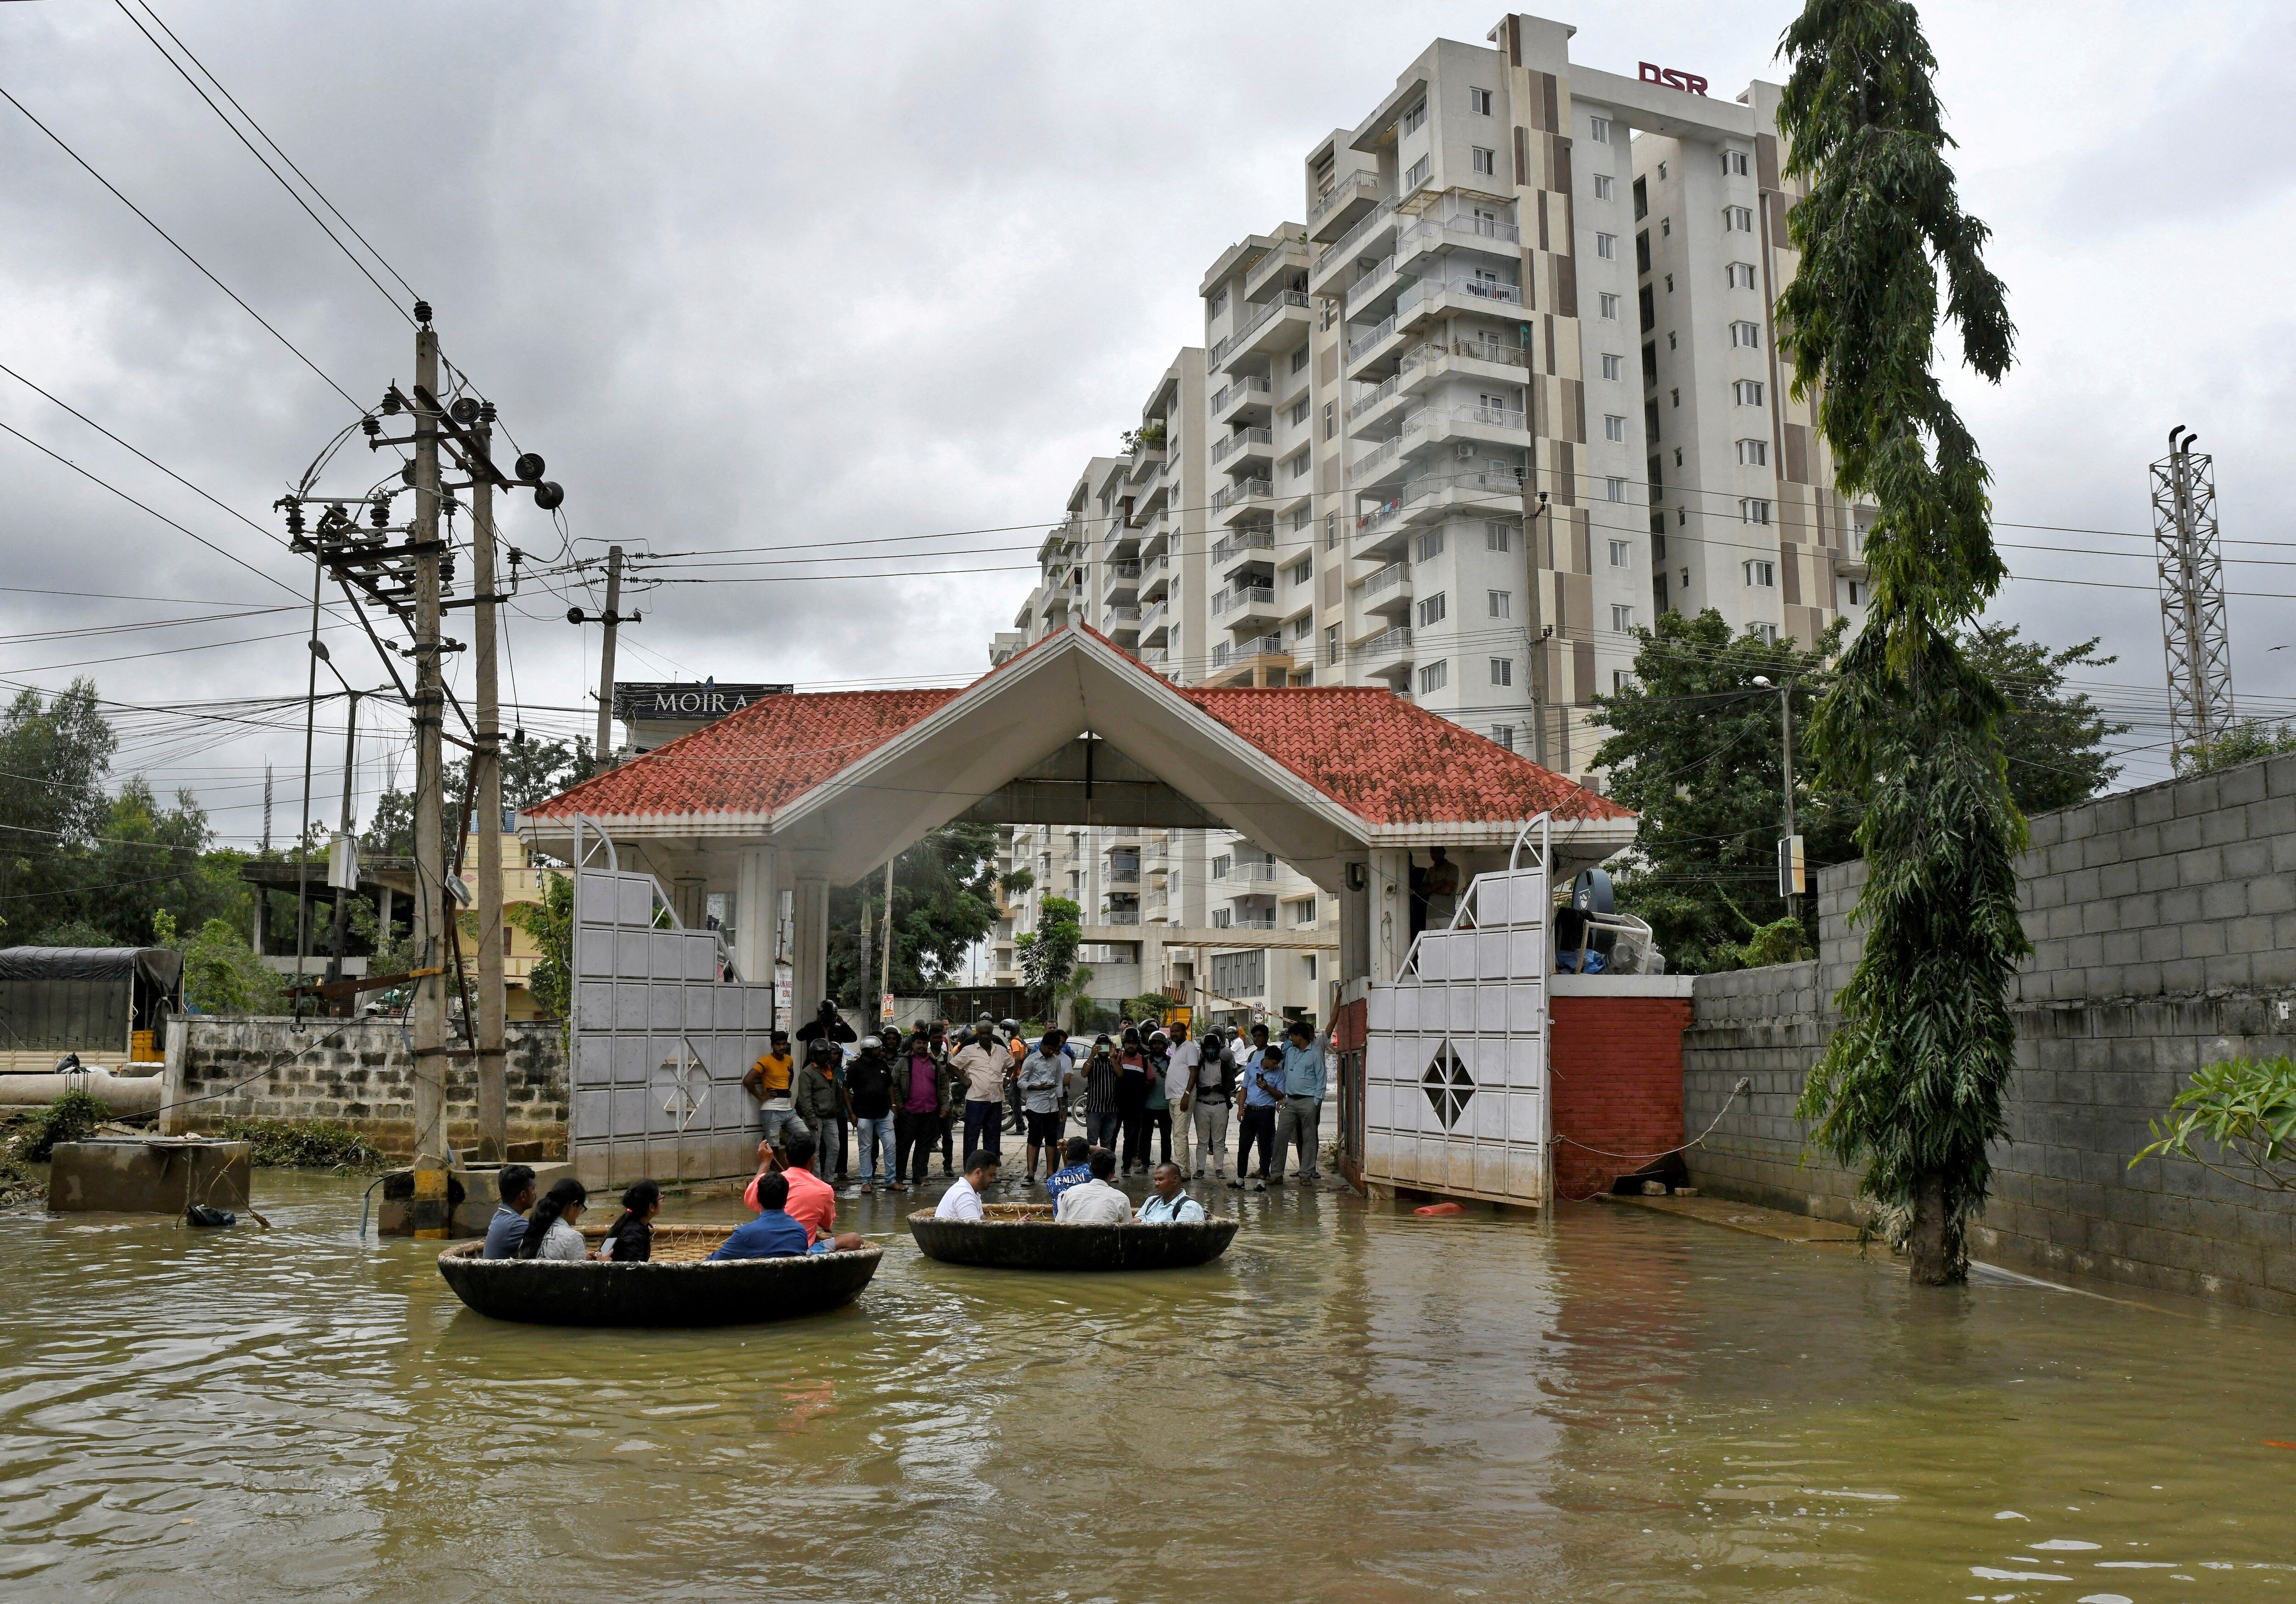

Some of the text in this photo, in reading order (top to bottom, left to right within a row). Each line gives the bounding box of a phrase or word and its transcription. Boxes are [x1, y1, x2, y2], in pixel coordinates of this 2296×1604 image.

[1638, 61, 1708, 97] DSR
[654, 693, 747, 712] MOIRA
[1055, 1173, 1085, 1186] R.MANI
